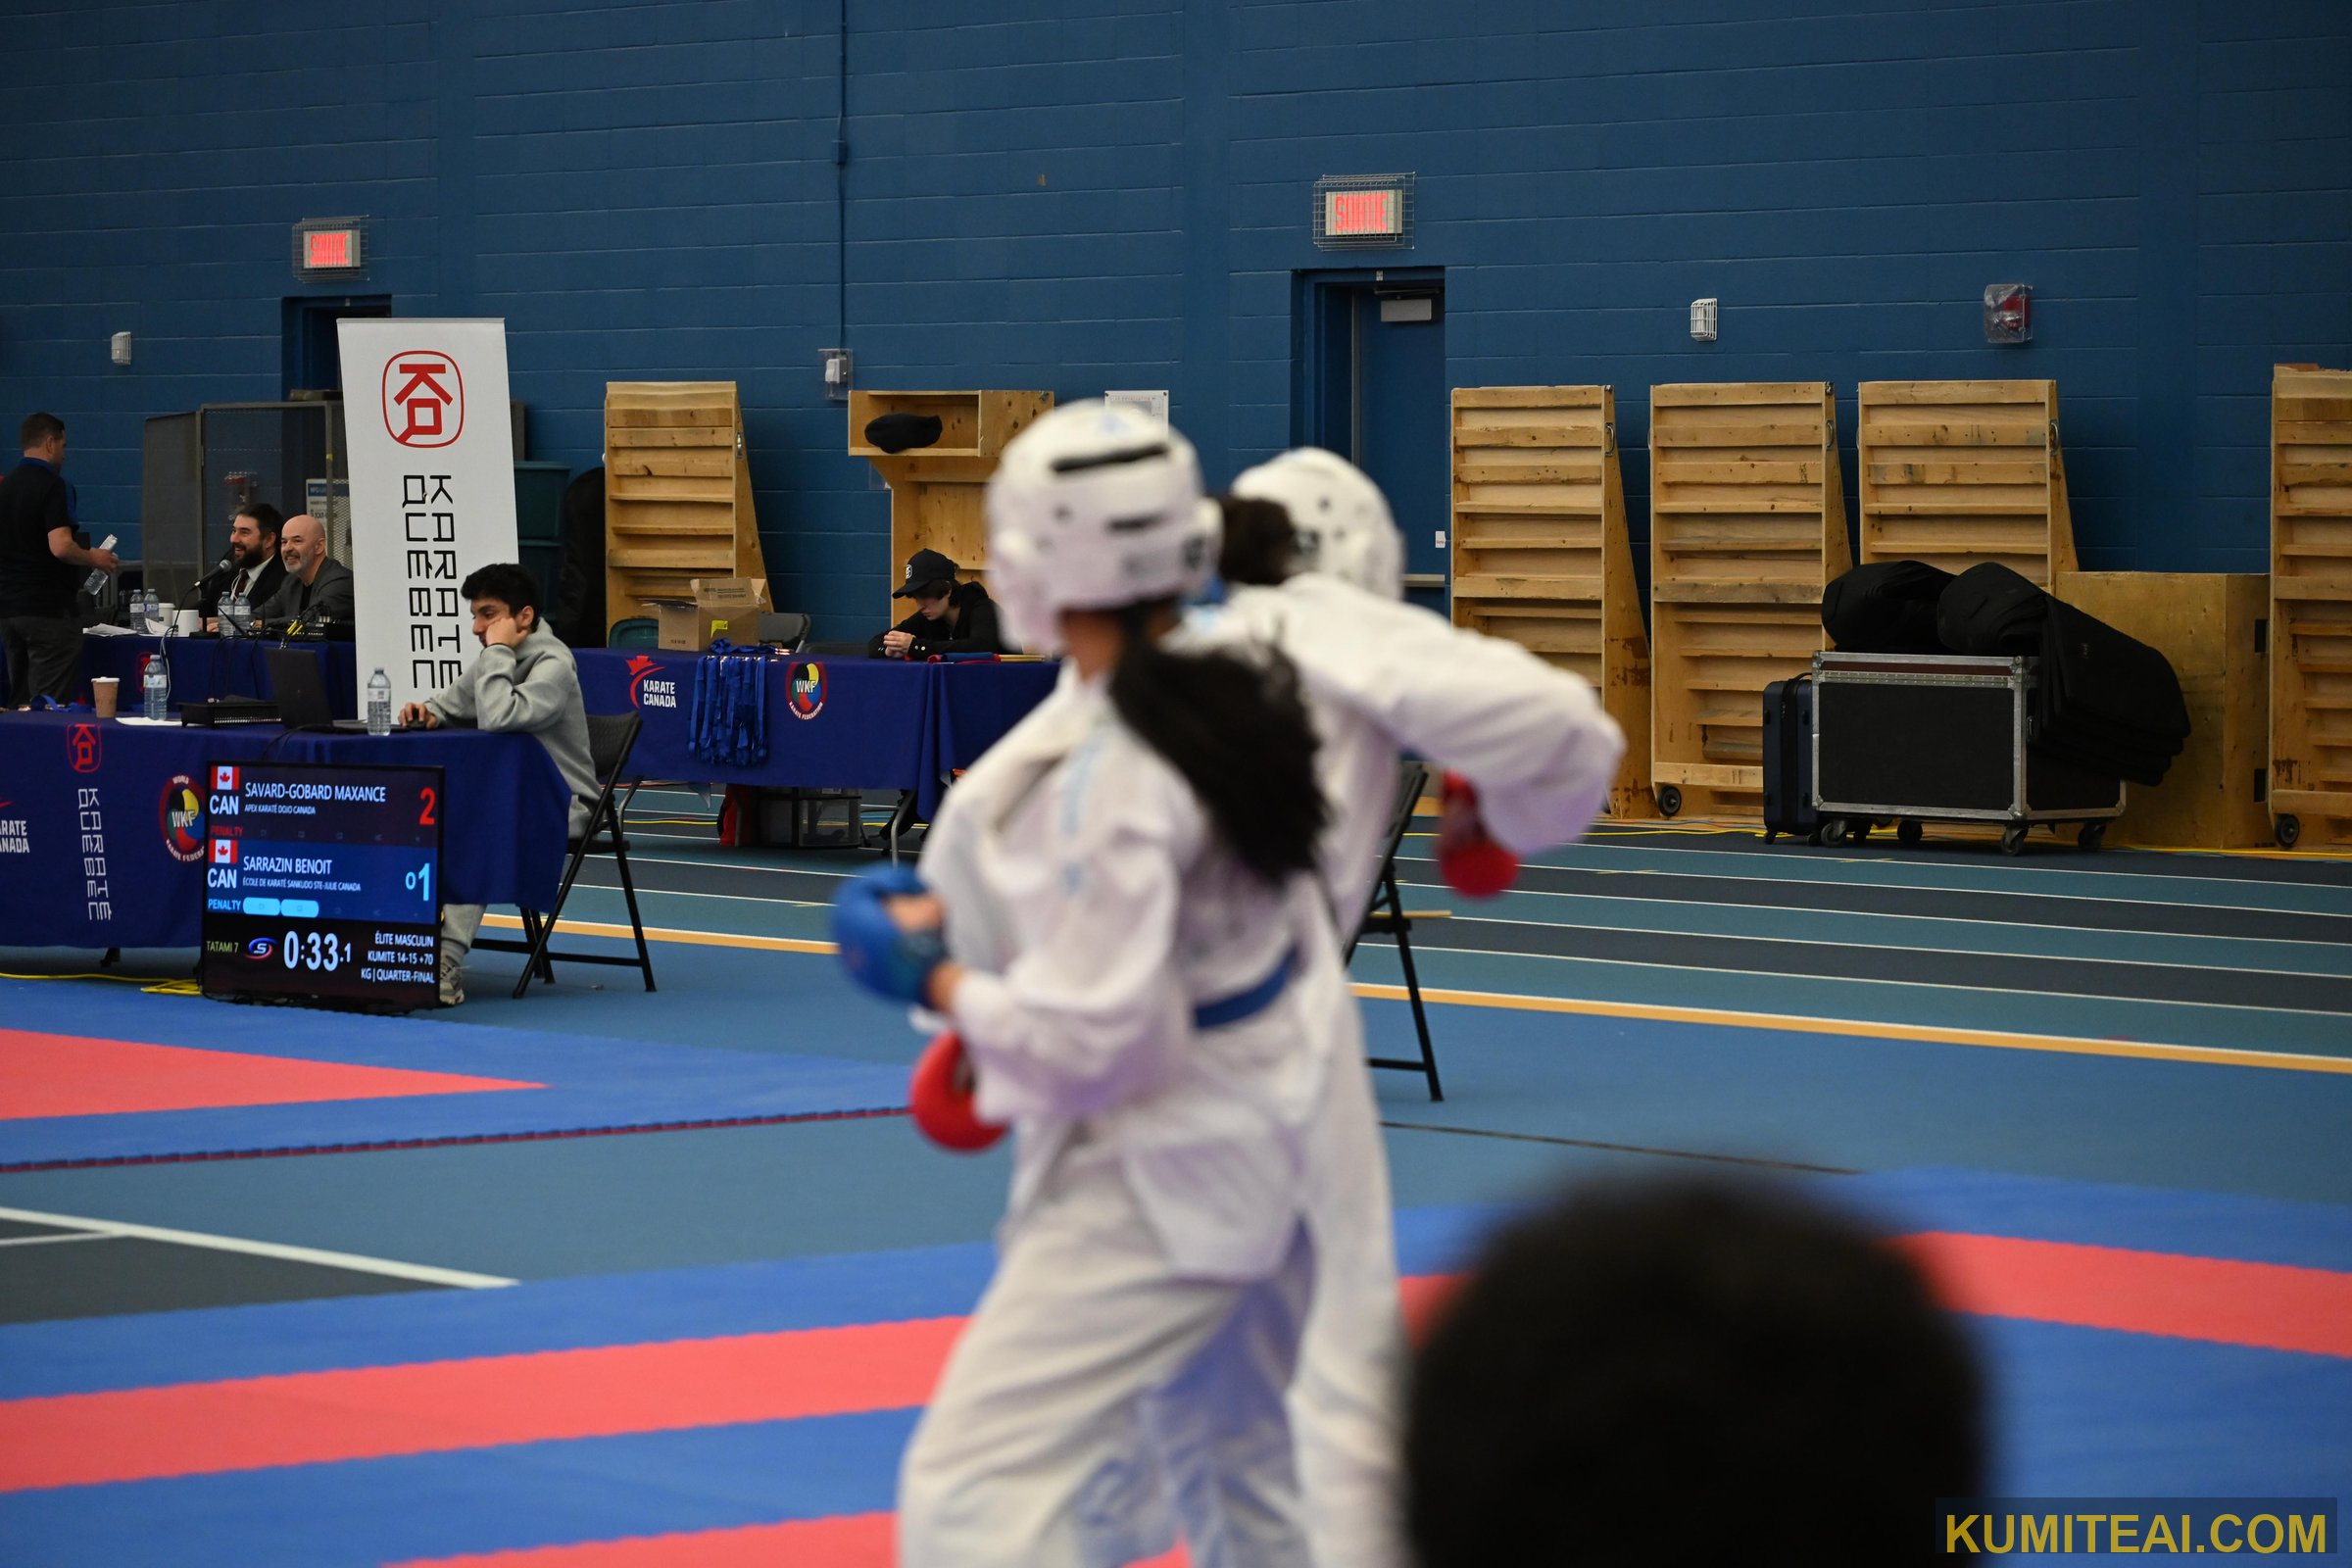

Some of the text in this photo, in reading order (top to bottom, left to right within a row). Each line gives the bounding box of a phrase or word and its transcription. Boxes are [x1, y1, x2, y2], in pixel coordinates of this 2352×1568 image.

[402, 474, 436, 689] QUÉBEC
[643, 679, 676, 695] KARATE
[796, 680, 816, 694] WKF
[643, 693, 677, 709] CANADA
[245, 783, 386, 803] SAVARD-GOBARD MAXANCE
[209, 795, 239, 815] CAN
[244, 804, 258, 812] APEX
[277, 805, 293, 814] DOJO
[293, 806, 316, 815] CANADA
[418, 787, 436, 825] 2
[172, 809, 196, 828] WKF
[0, 819, 27, 836] RATE
[182, 845, 205, 862] FEDERA
[243, 856, 333, 875] SARRAZIN BENOIT
[207, 867, 237, 888] CAN
[259, 878, 267, 887] DE
[337, 882, 362, 892] CANADA
[208, 898, 241, 910] PENALTY
[206, 940, 239, 954] TATAMI 7
[374, 930, 434, 948] ÉLITE MASCULIN
[367, 950, 434, 965] KUMITE 14-15 +70
[361, 967, 372, 980] KG
[376, 968, 436, 984] QUARTER-FINAL
